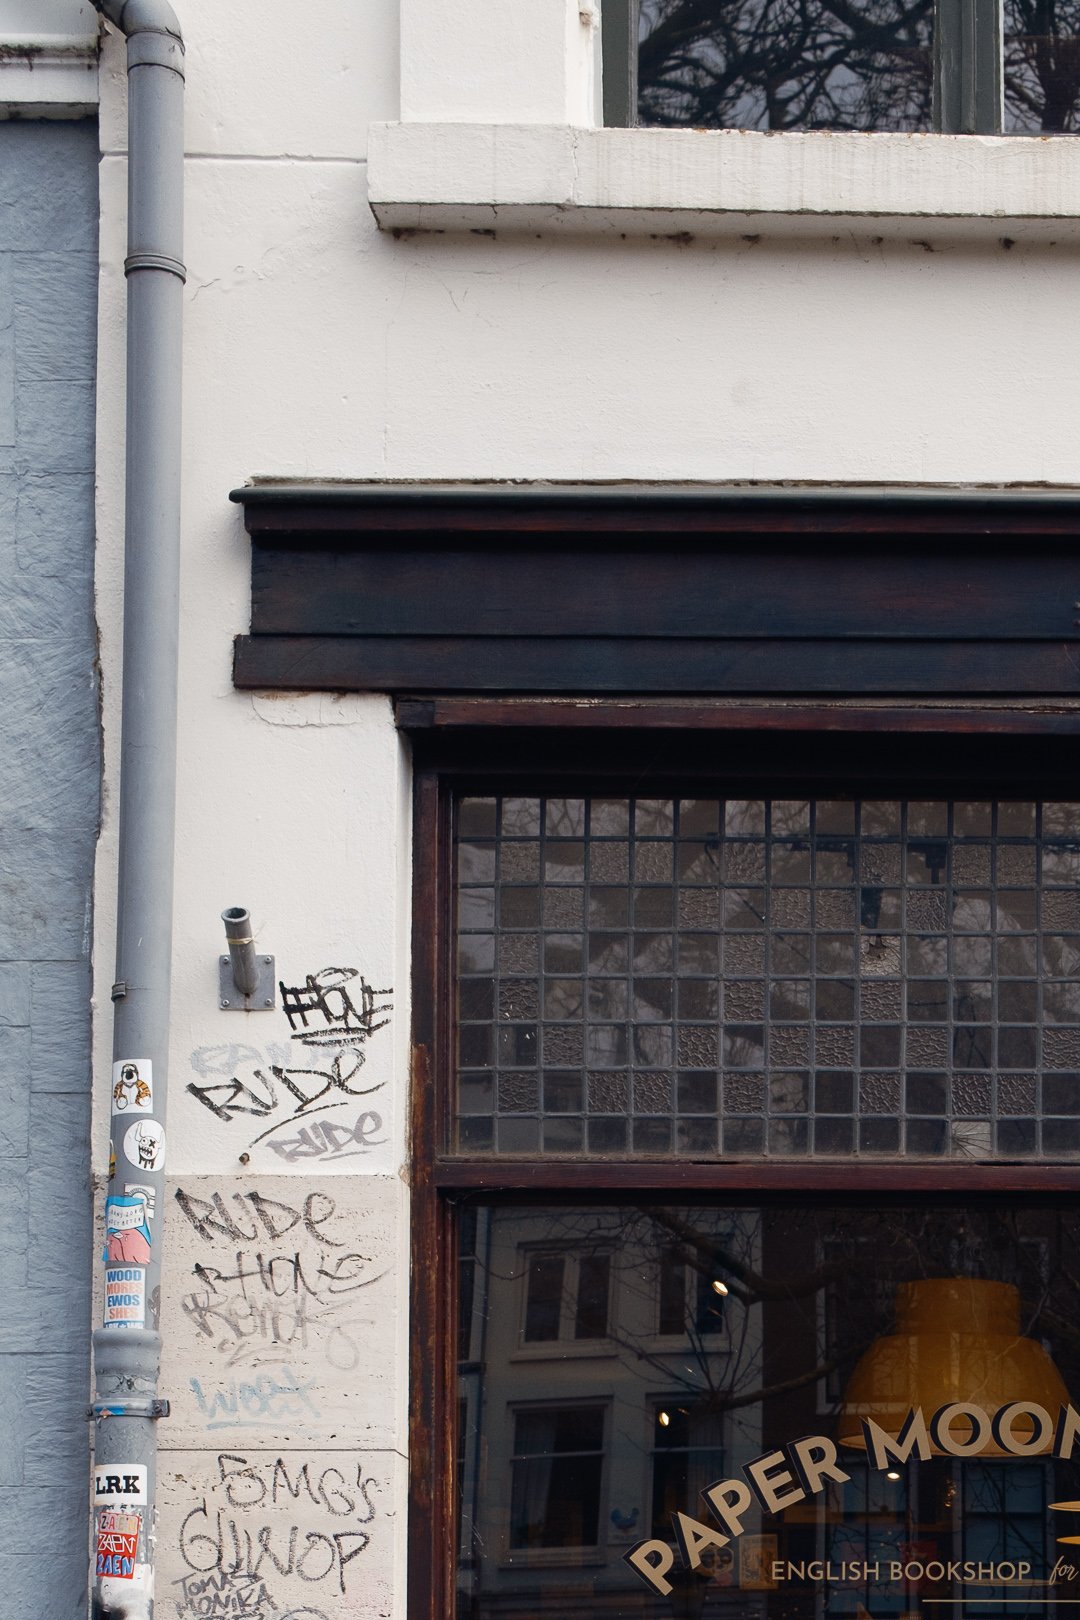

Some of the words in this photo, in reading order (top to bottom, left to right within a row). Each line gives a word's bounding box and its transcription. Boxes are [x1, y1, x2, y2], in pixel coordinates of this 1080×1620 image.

[107, 1269, 142, 1282] WOOD
[107, 1283, 144, 1295] MORES
[109, 1307, 139, 1320] SHES
[95, 1475, 140, 1495] LRK
[623, 1435, 851, 1596] PAPER
[772, 1561, 879, 1581] ENGLISH
[890, 1561, 1031, 1581] BOOKSHOP
[1048, 1554, 1080, 1585] for
